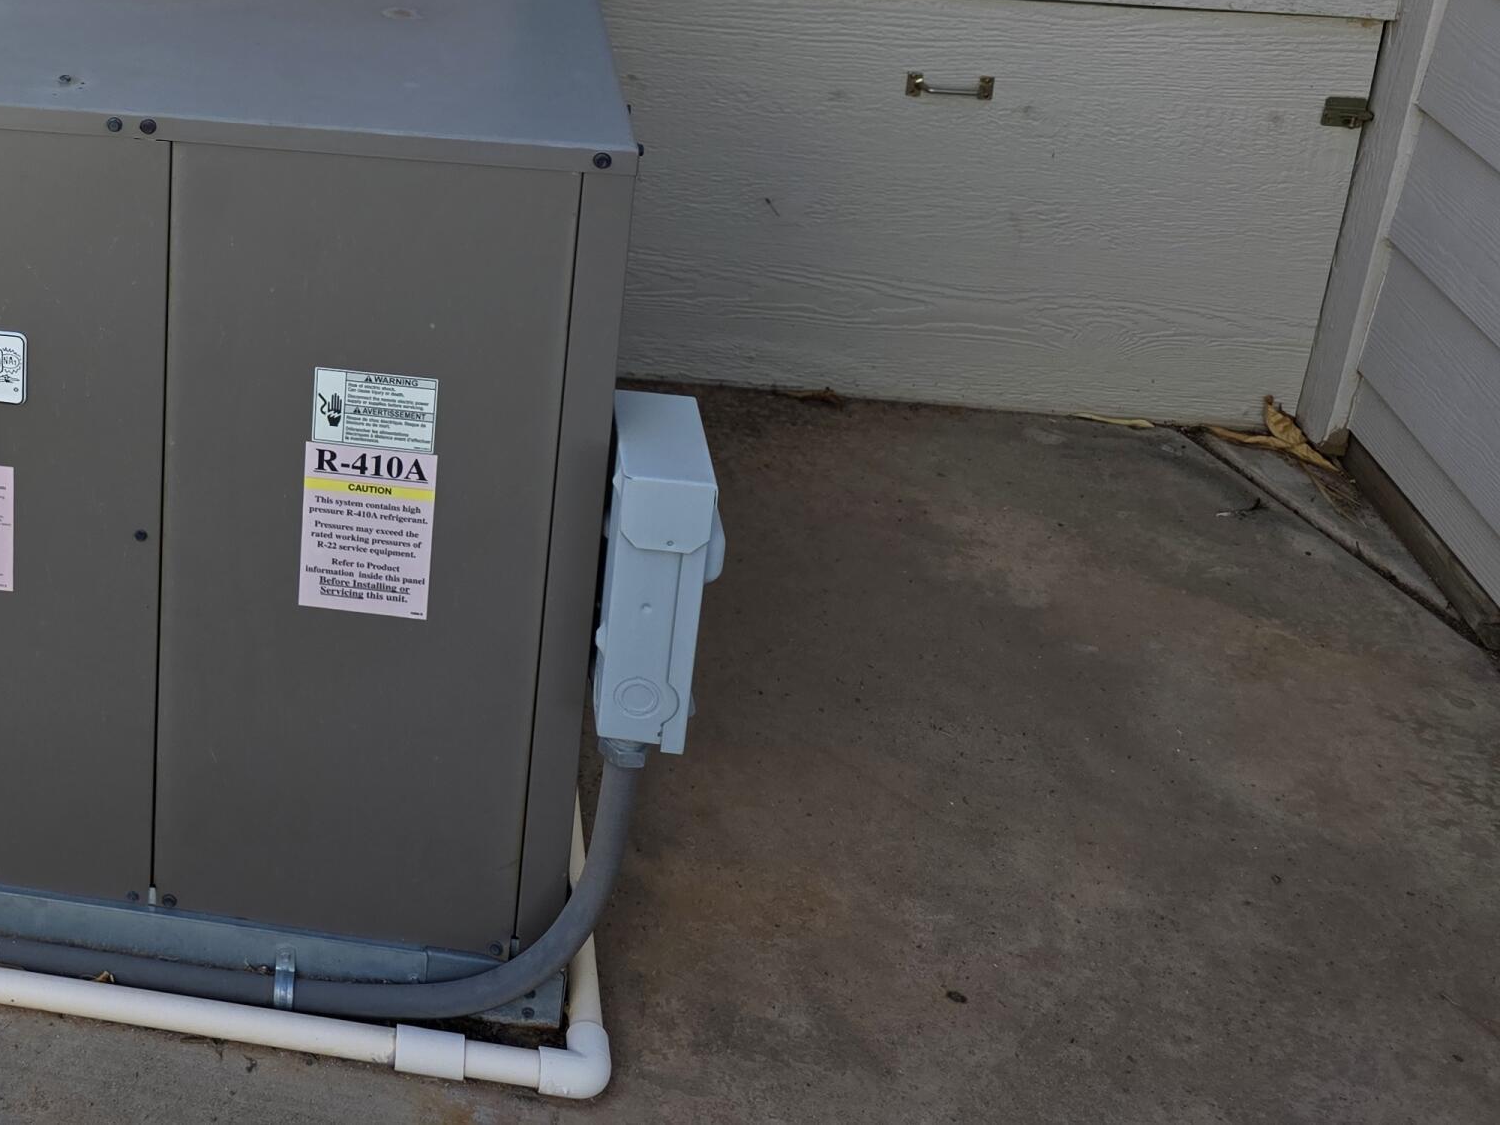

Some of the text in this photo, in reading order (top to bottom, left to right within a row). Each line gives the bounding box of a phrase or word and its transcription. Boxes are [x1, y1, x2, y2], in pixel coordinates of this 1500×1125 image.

[374, 376, 418, 387] WARNING
[362, 407, 425, 420] AVERTISSEMENT
[315, 448, 428, 482] R-410A
[348, 483, 392, 495] CAUTION
[314, 495, 421, 514] This system contains high
[308, 506, 428, 525] pressure R-410A refrigerant.
[314, 520, 419, 538] Pressures may exceed the
[311, 531, 422, 549] rated working pressures of
[317, 541, 416, 558] R-22 service equipment.
[331, 558, 354, 568] Refer
[366, 562, 400, 572] Product
[305, 565, 425, 585] information inside this panel
[319, 576, 410, 594] Before Installing or
[320, 586, 408, 603] Servicing this unit.
